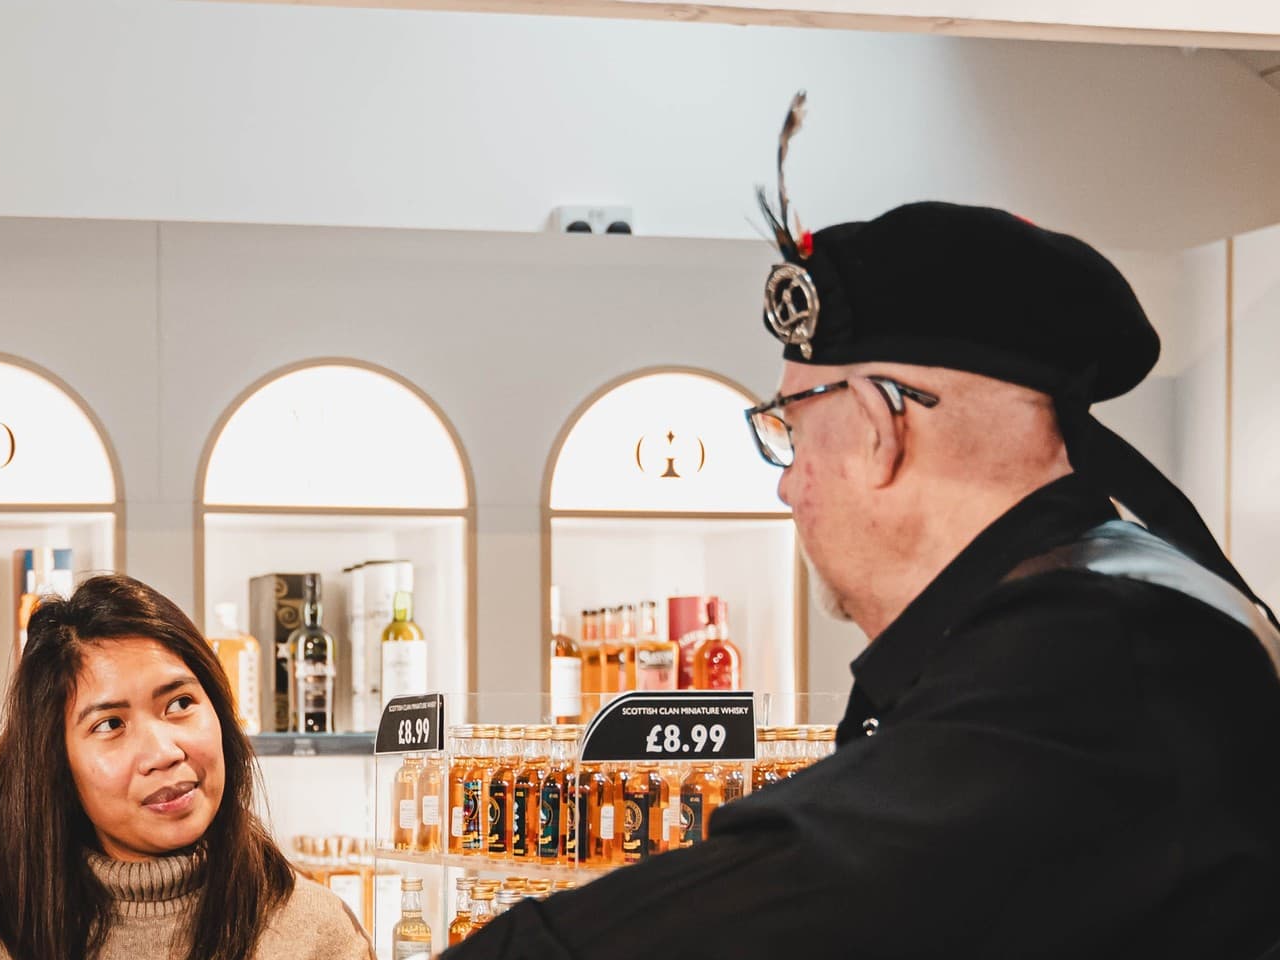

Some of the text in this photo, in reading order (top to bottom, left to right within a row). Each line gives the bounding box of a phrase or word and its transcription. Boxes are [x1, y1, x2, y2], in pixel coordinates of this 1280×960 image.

[622, 706, 749, 716] SCOTTISH CLAN MINIATURE WHISKY
[398, 717, 430, 746] £8.99
[645, 723, 727, 753] £8.99
